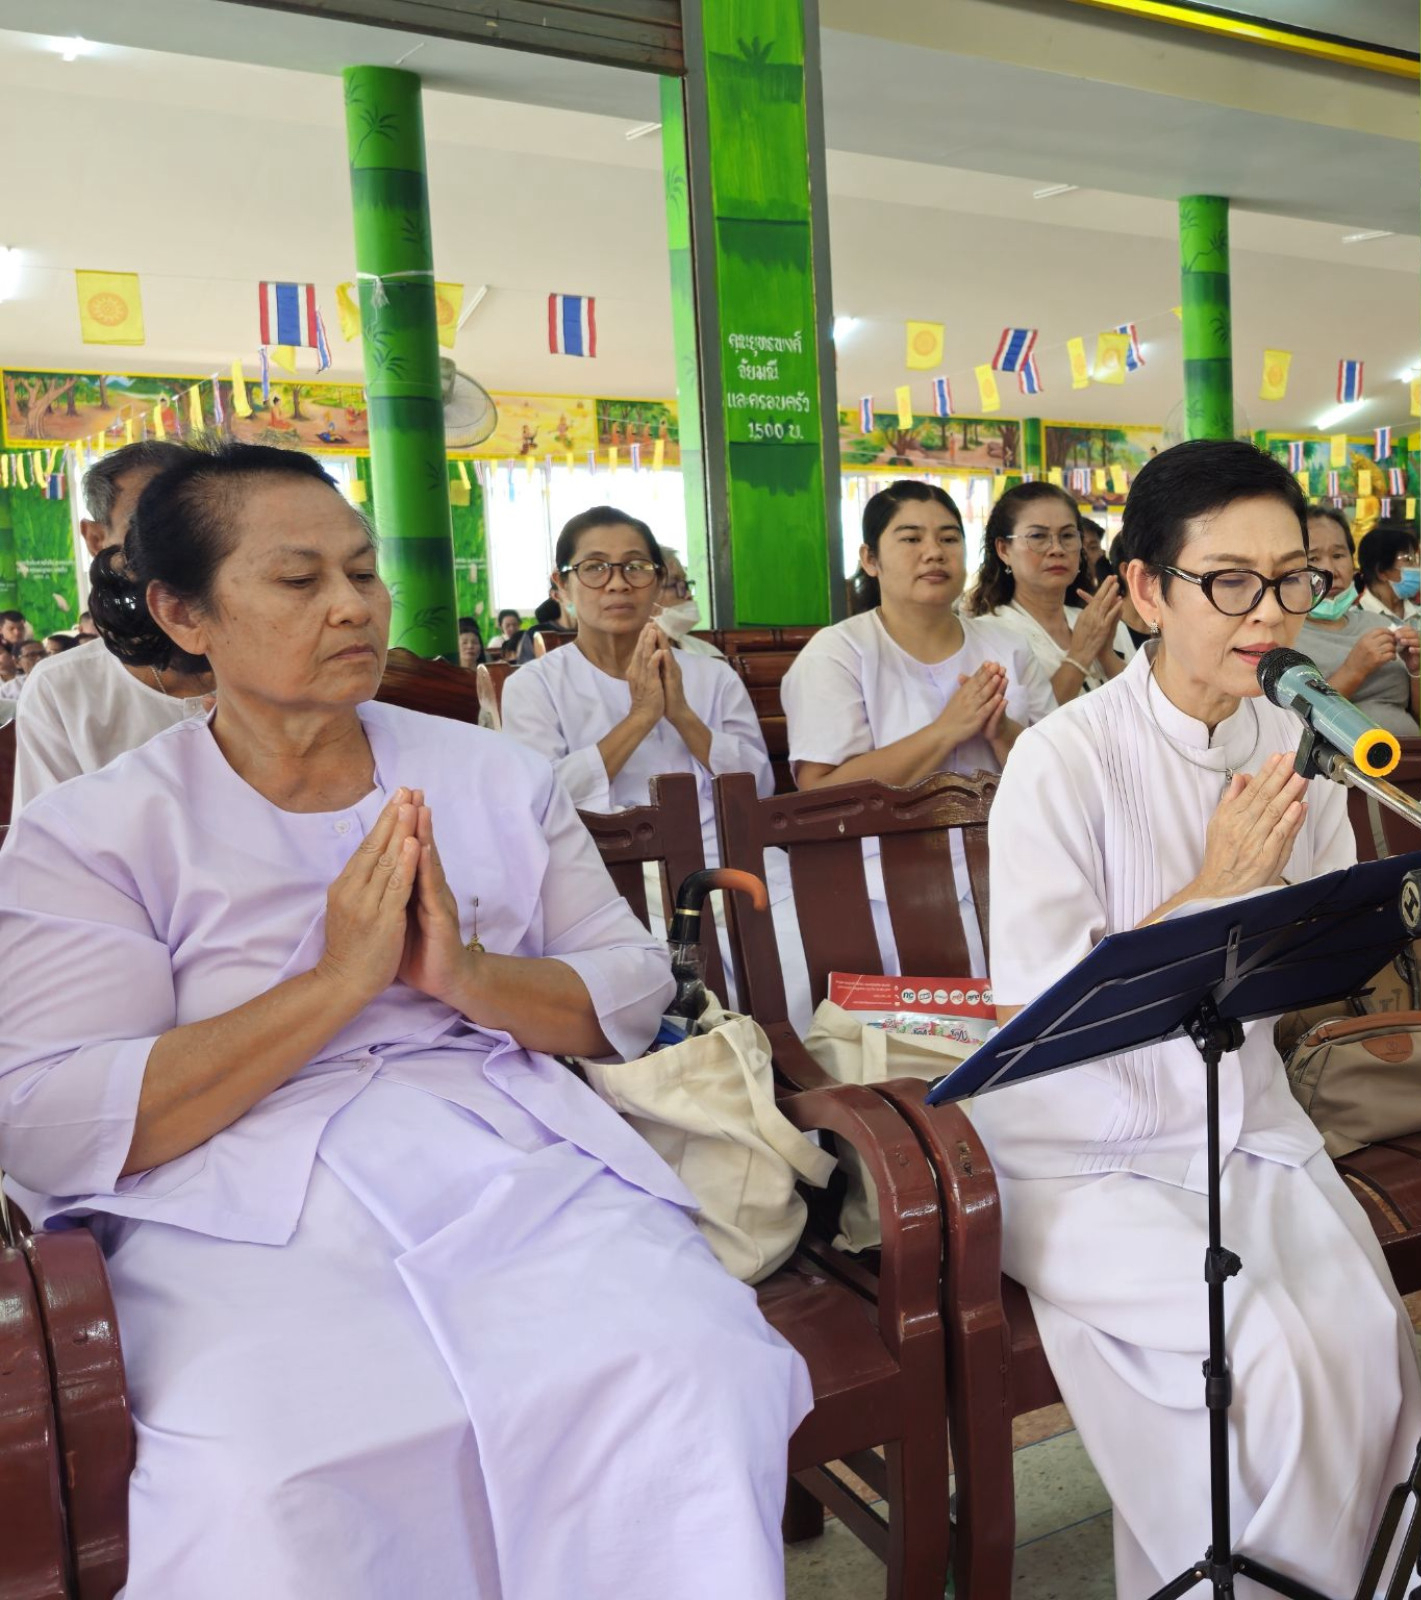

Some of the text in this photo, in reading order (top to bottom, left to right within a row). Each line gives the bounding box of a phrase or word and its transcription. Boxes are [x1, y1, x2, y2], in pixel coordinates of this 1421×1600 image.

[727, 390, 810, 414] และครอบครัว
